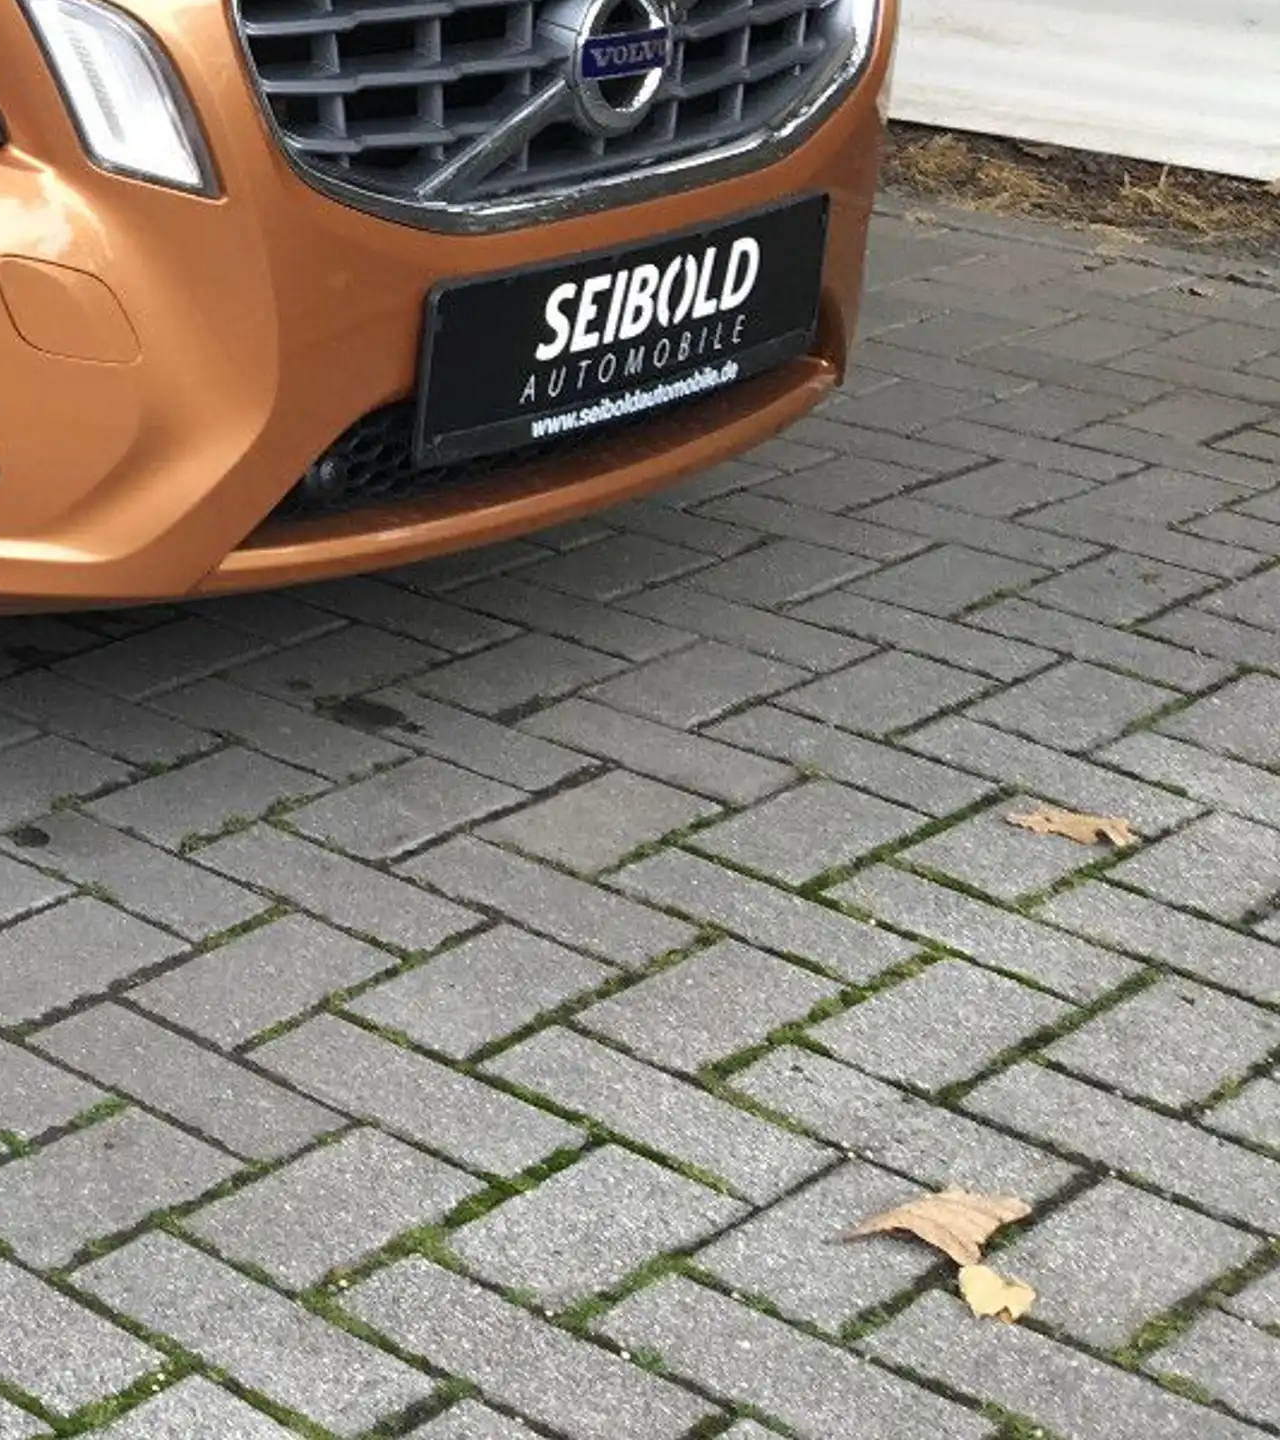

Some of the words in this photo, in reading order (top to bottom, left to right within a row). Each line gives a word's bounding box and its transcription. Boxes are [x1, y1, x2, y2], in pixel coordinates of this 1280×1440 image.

[534, 236, 761, 362] SEIBOLD
[519, 314, 747, 405] AUTOMOBILE
[530, 359, 740, 439] www.seiboldautomobile.de
